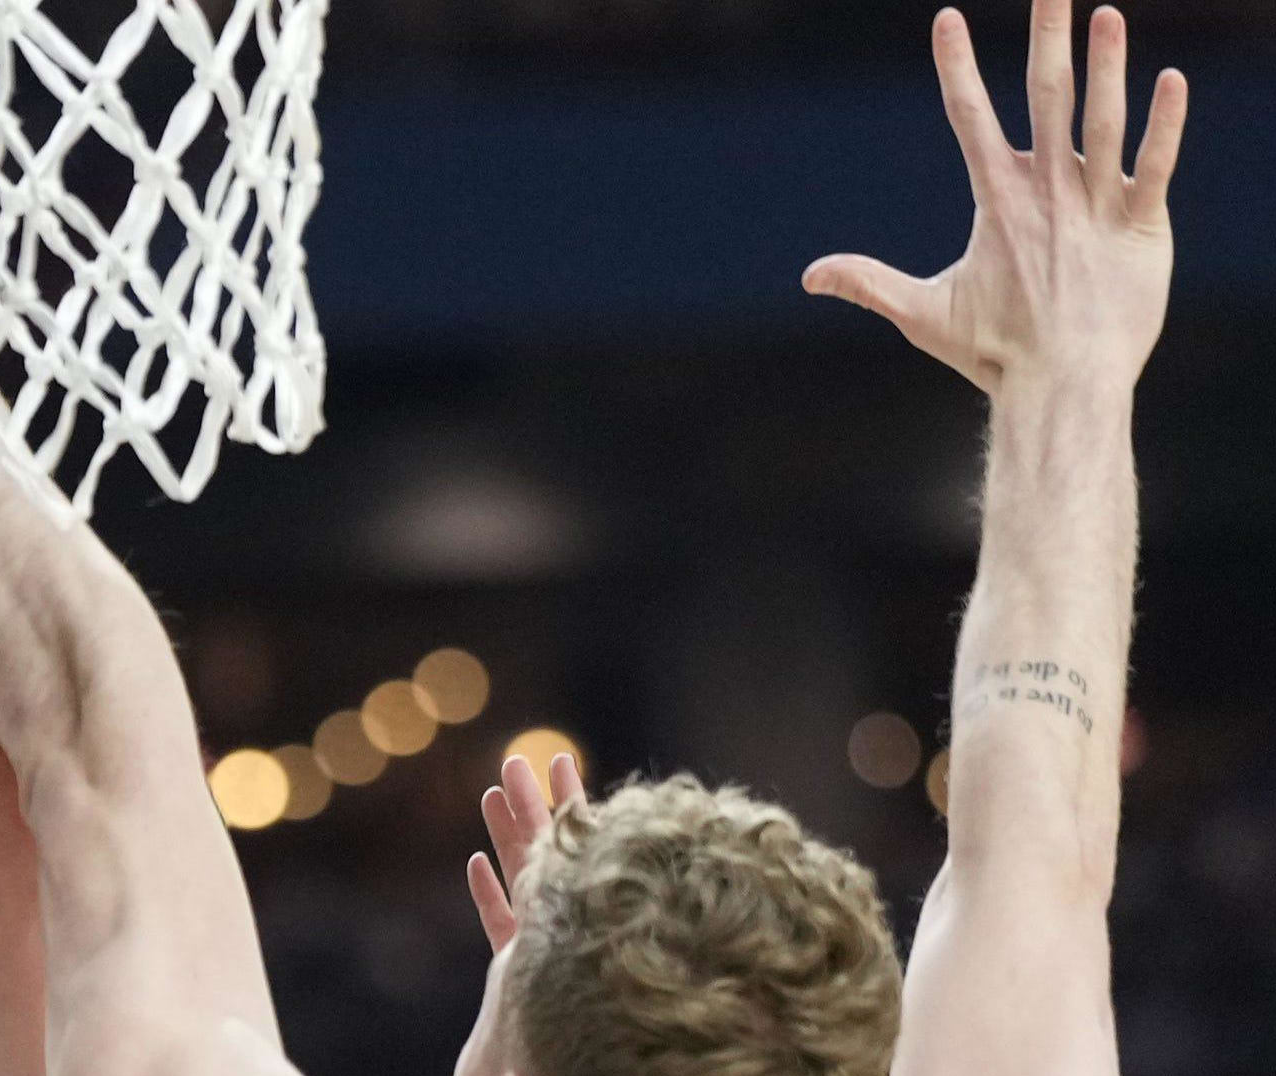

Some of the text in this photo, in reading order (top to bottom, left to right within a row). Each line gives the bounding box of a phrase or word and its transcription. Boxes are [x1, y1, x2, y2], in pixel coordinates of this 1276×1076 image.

[1019, 660, 1059, 682] die
[1068, 669, 1087, 695] to
[1027, 688, 1071, 714] live
